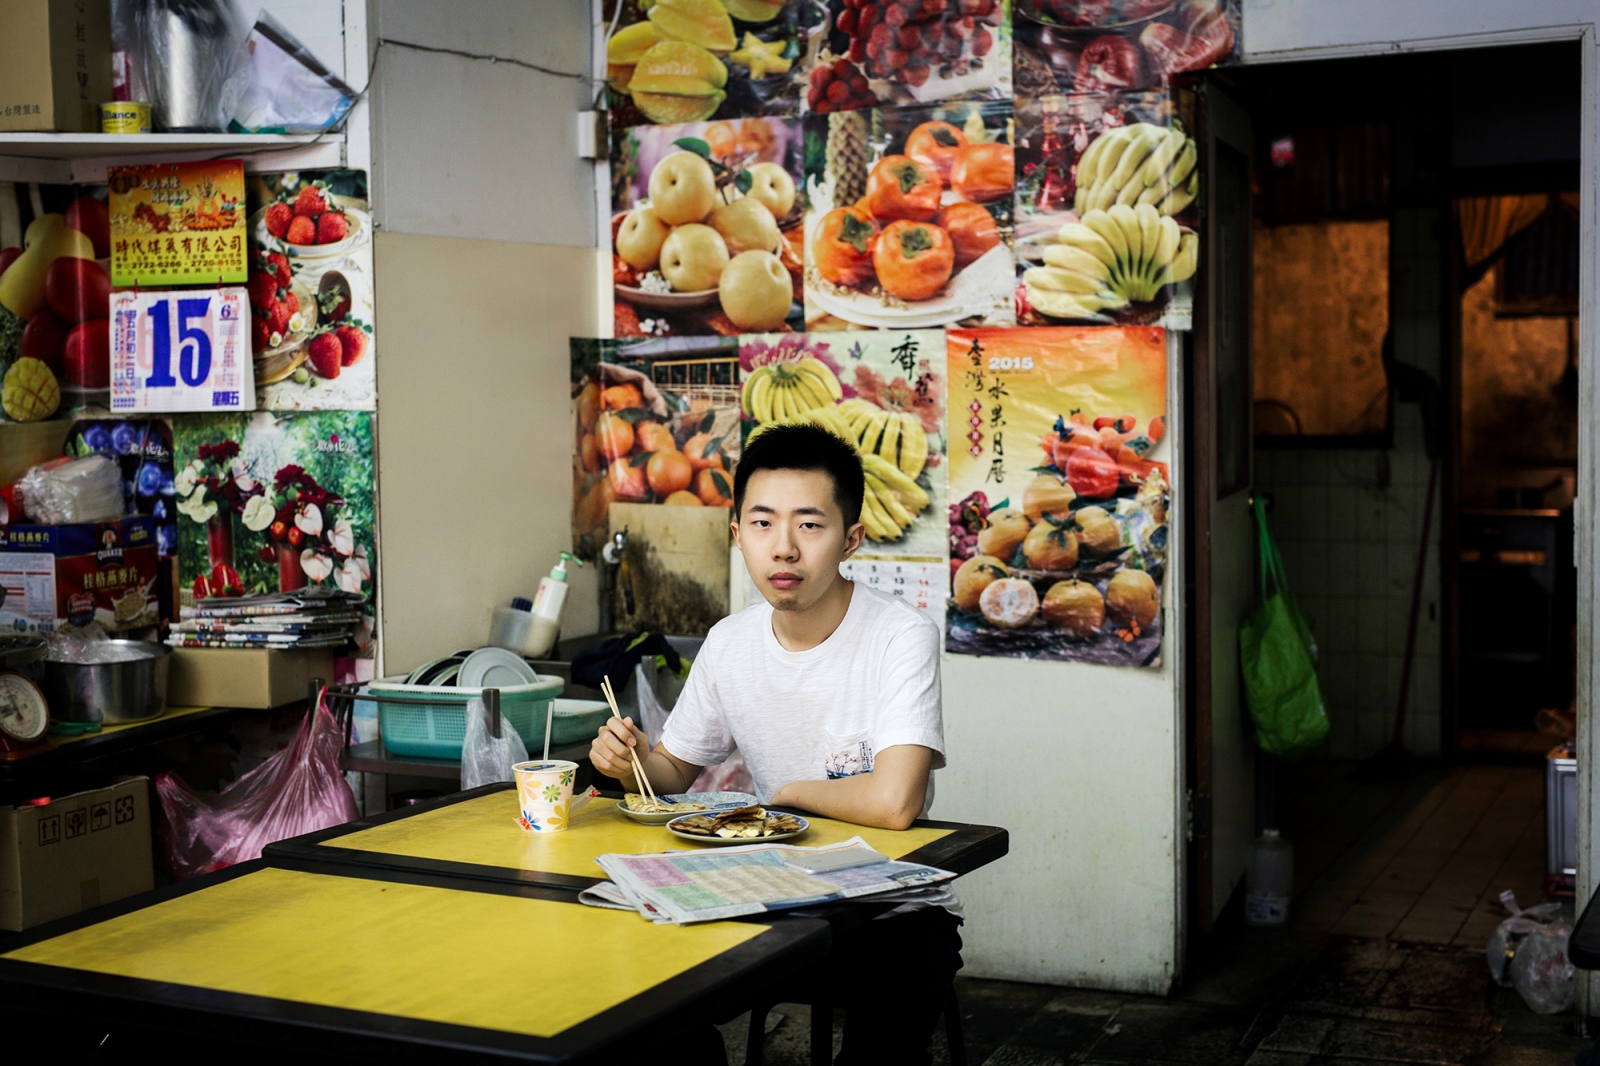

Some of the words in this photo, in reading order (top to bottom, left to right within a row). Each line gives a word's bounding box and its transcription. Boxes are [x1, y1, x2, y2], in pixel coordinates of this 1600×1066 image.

[221, 304, 231, 319] 6
[145, 296, 212, 388] 15
[988, 357, 1035, 370] 2015
[212, 390, 240, 407] 星期五
[97, 547, 124, 561] QUAKER
[83, 566, 139, 590] 桂格燕麥片
[894, 577, 904, 585] 13
